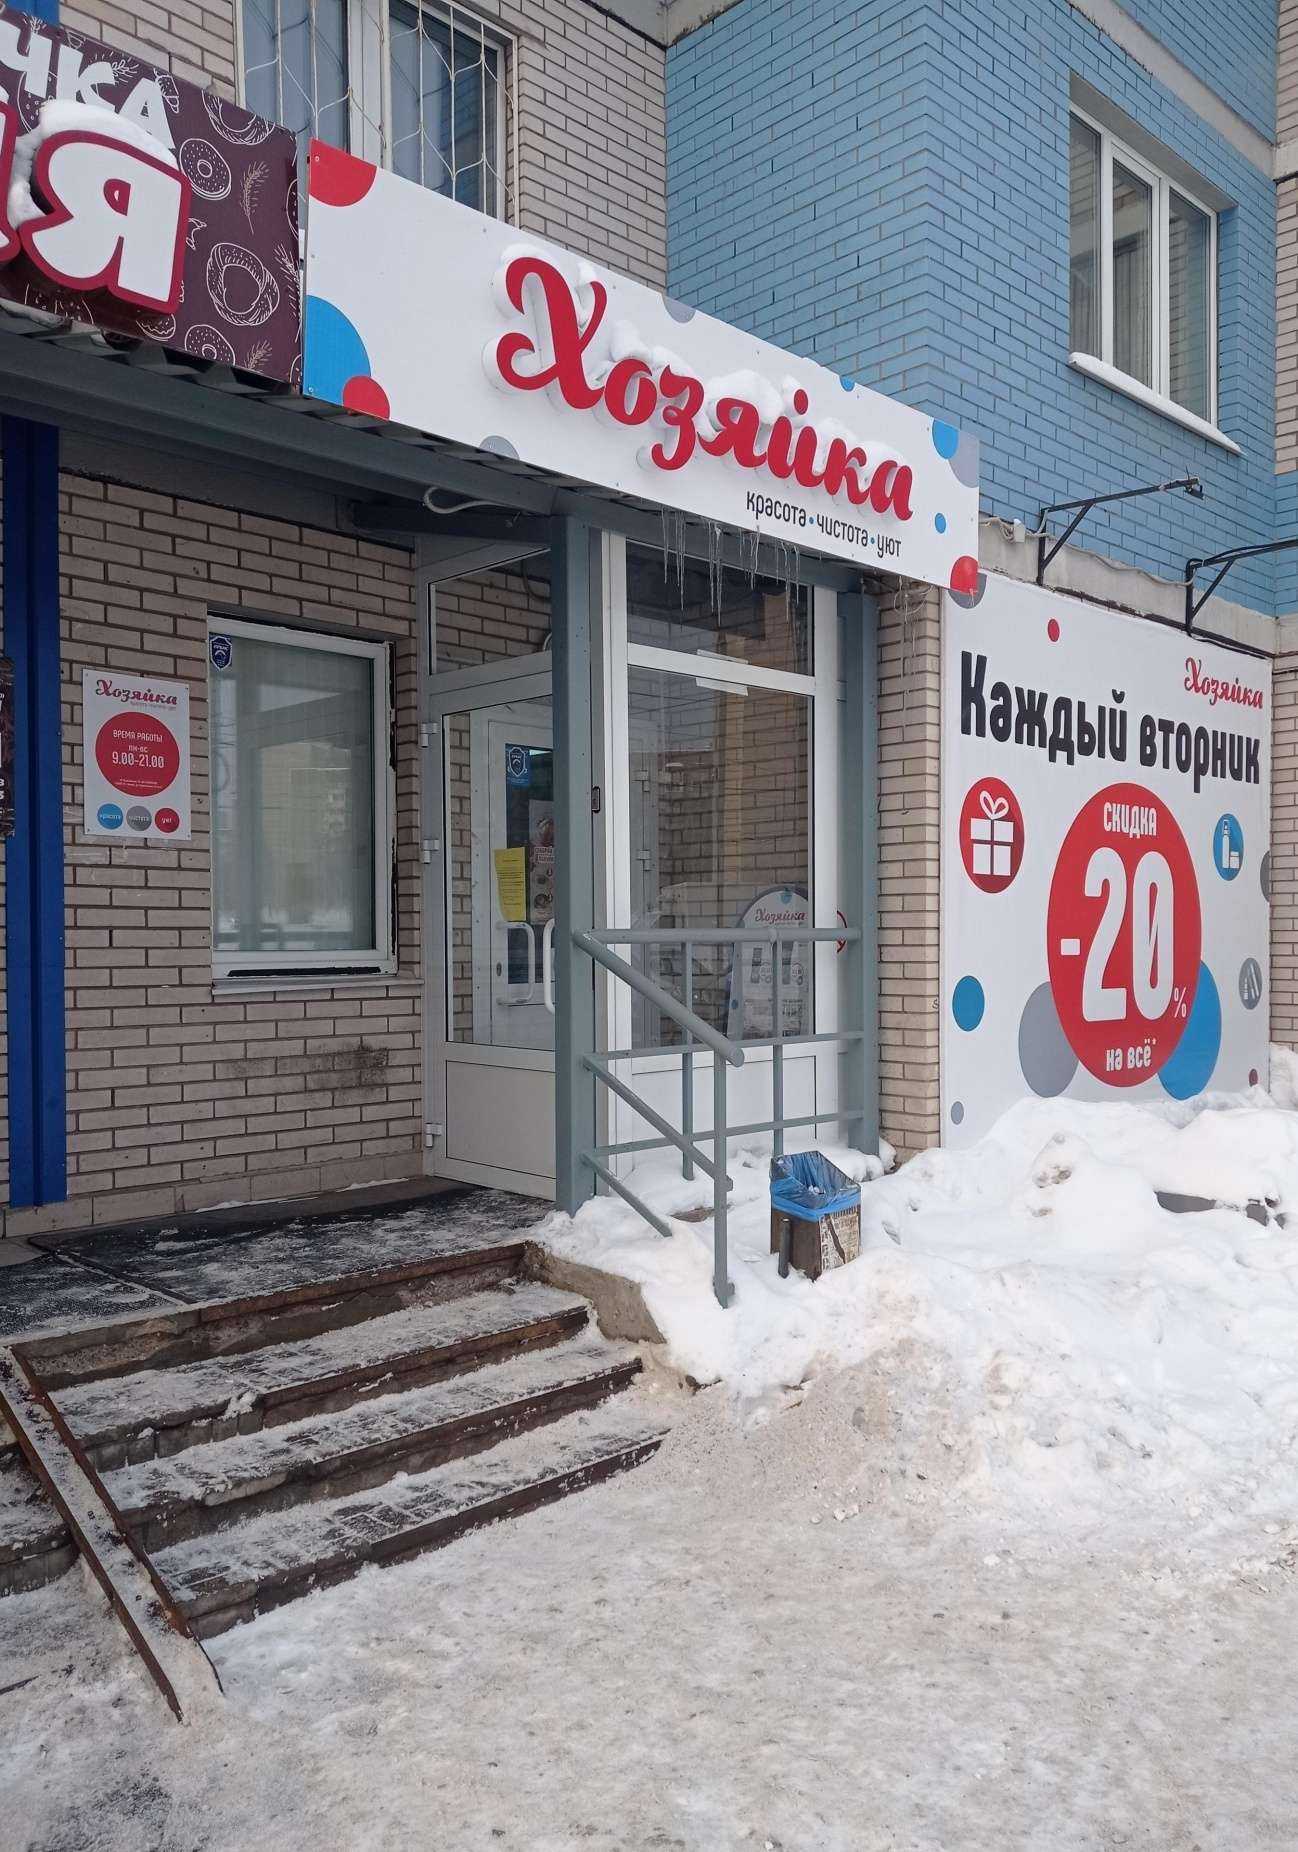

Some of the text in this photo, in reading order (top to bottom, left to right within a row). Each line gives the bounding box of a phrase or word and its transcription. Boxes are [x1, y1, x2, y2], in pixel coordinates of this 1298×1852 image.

[496, 256, 914, 521] Хозяйка
[746, 491, 902, 558] красота чистота уют
[95, 679, 177, 705] Хозяйка
[1184, 657, 1263, 710] Хозяйка
[113, 729, 163, 742] ВРЕМЯ РАБОТЫ
[961, 650, 1260, 794] Каждый вторник
[112, 751, 164, 768] 9.00-21.00
[1106, 1048, 1123, 1072] на
